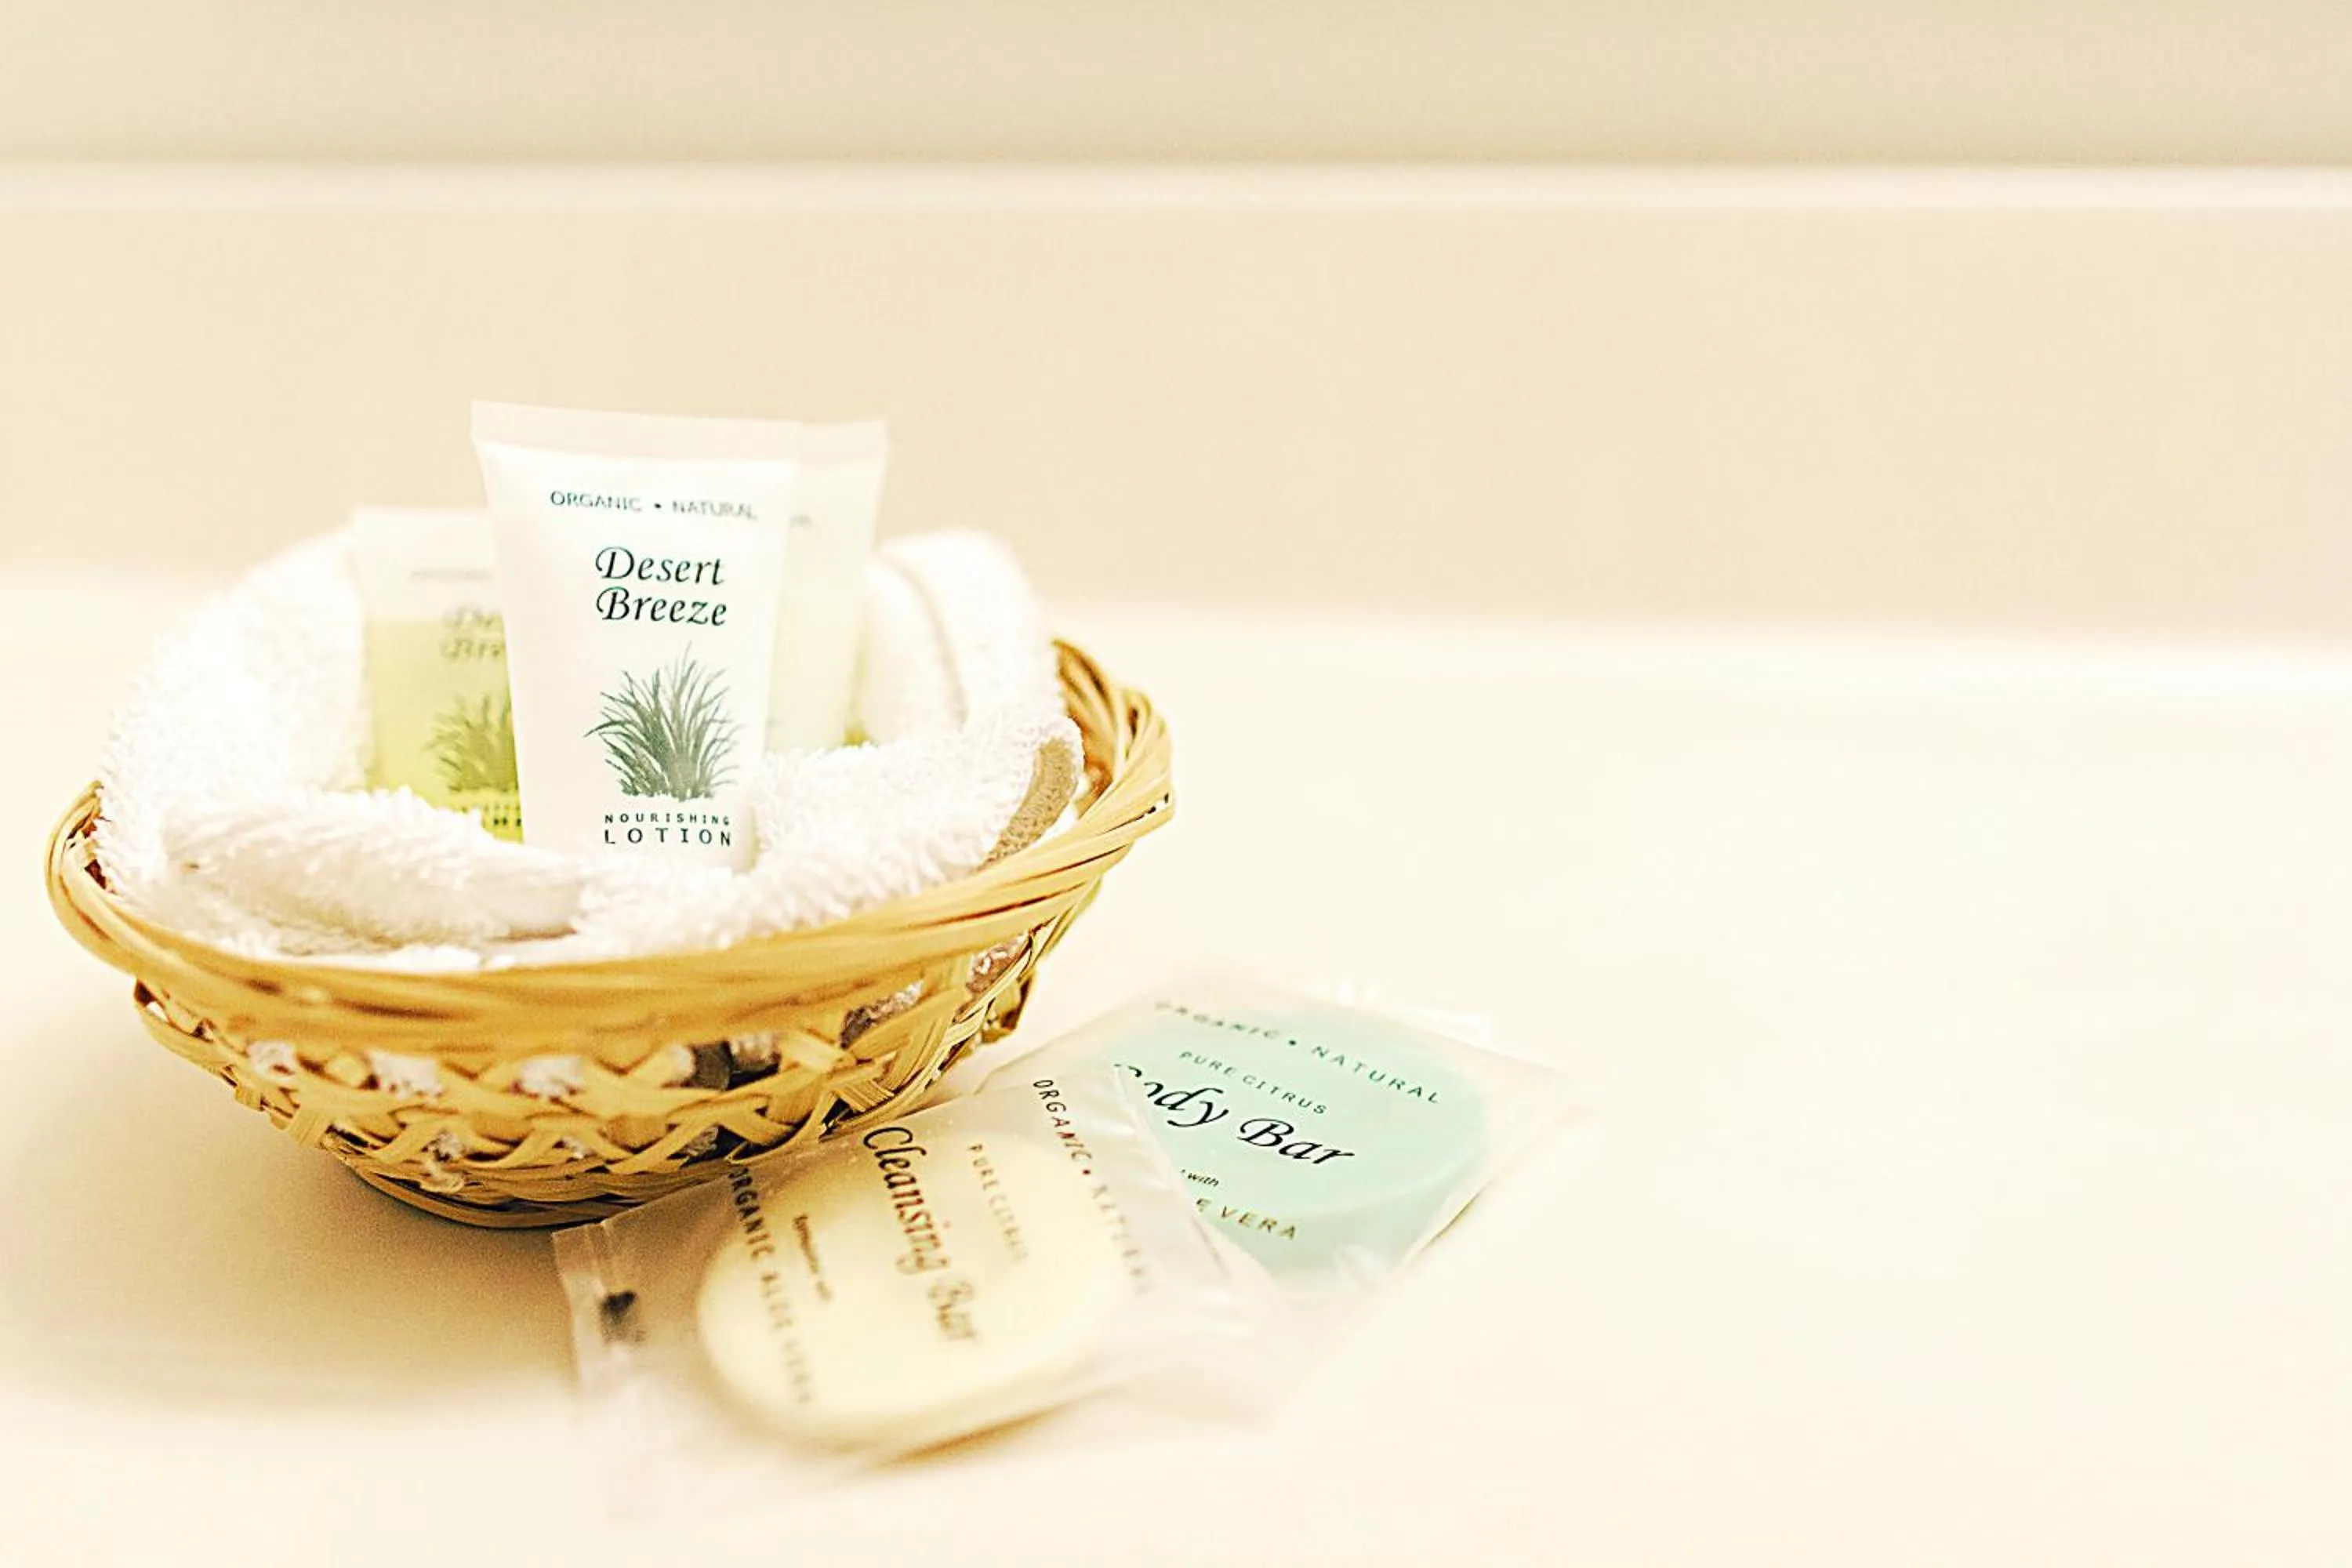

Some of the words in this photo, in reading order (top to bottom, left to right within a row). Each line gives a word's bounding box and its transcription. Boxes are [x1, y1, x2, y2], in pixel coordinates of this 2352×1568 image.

[550, 489, 642, 514] ORGANIC
[672, 499, 758, 521] NATURAL
[595, 546, 724, 586] Desert
[596, 586, 728, 626] Breeze
[604, 812, 730, 826] NOURISHING
[604, 827, 731, 847] LOTION
[1178, 1051, 1237, 1076] PURE
[1242, 1074, 1327, 1114] CITRUS
[1310, 1044, 1439, 1104] NATURAL
[1033, 1079, 1094, 1161] ORGANIC
[1236, 1117, 1356, 1164] Bar
[1187, 1171, 1220, 1188] with
[728, 1165, 776, 1260] ORGANIC
[862, 1126, 952, 1276] Cleansing
[1220, 1206, 1298, 1241] VERA
